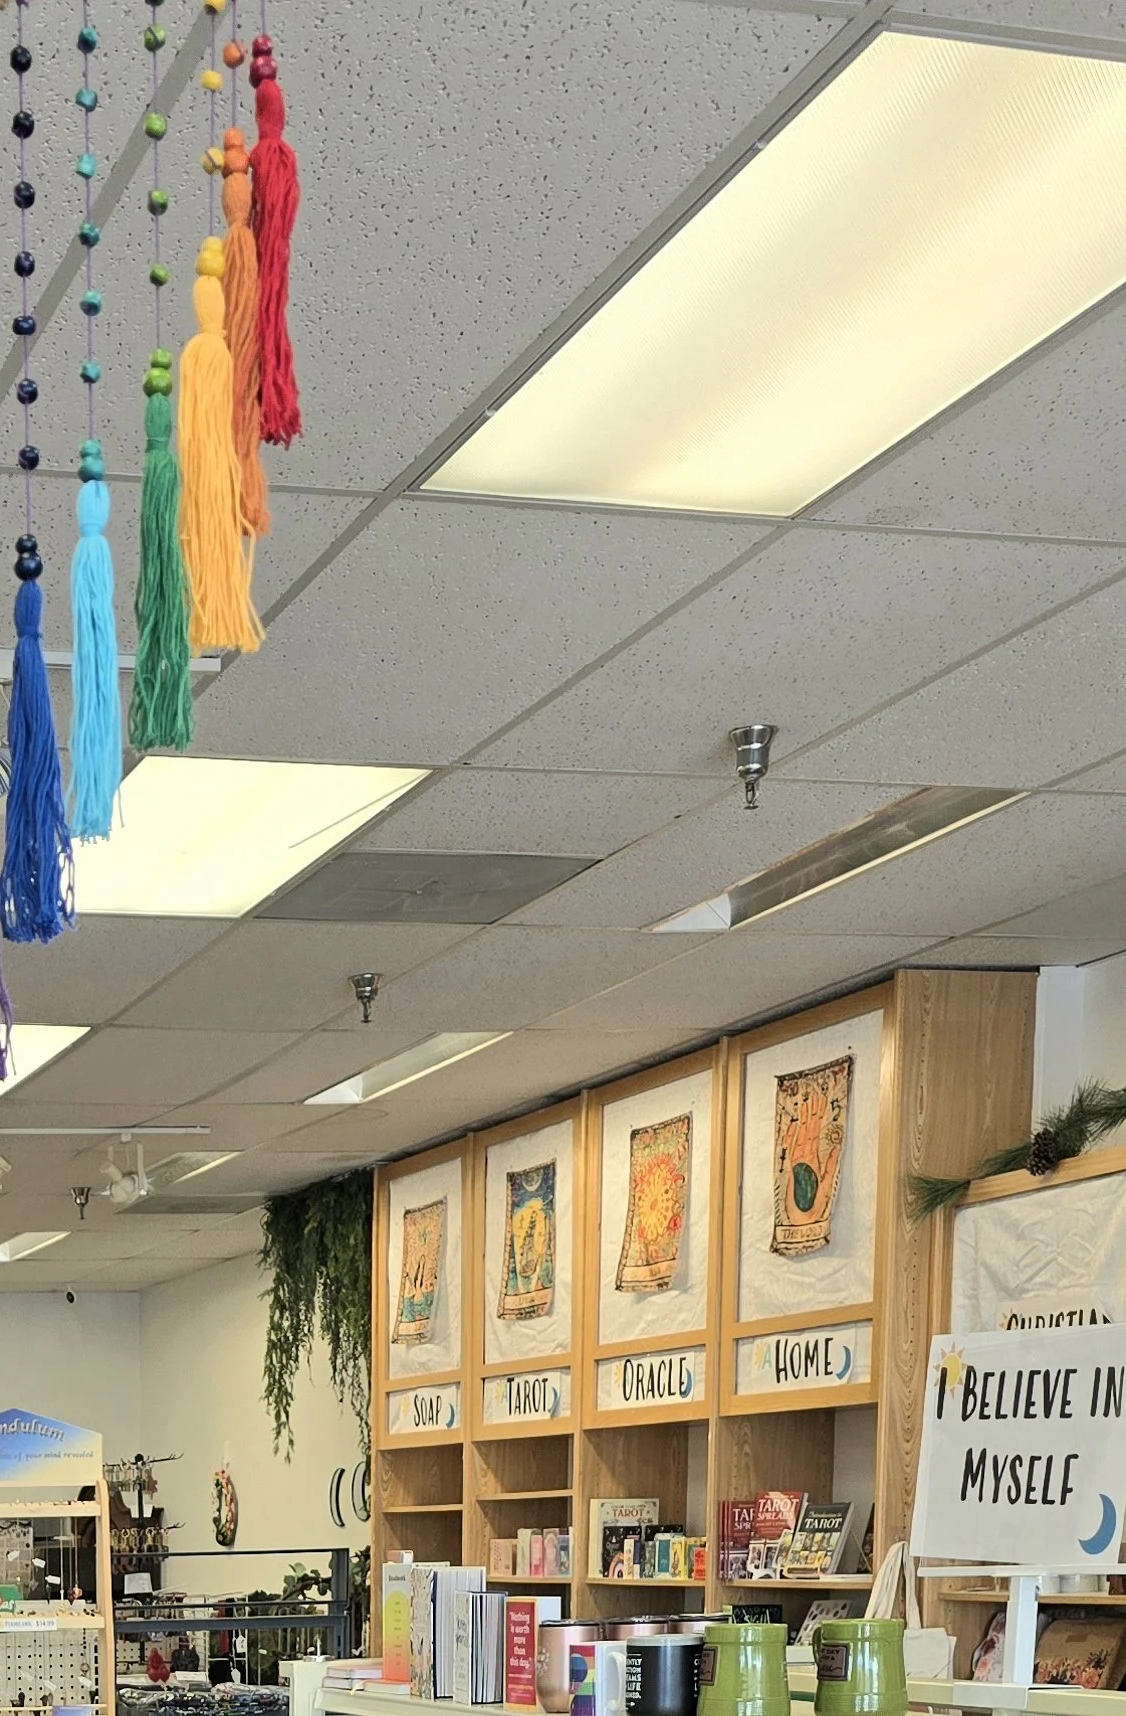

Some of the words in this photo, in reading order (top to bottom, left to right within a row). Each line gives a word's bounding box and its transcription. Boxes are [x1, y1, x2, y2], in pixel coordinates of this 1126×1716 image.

[622, 1356, 687, 1402] ORACLE
[775, 1337, 834, 1384] HOME
[414, 1393, 442, 1427] SOAP
[507, 1377, 548, 1416] TAROT
[936, 1366, 948, 1420] I
[961, 1365, 1078, 1422] BELIEVE
[1090, 1366, 1125, 1418] IN
[960, 1447, 1080, 1506] MYSELF
[612, 1508, 644, 1518] TAROT
[758, 1499, 799, 1512] TAROT
[805, 1518, 843, 1529] TAROT
